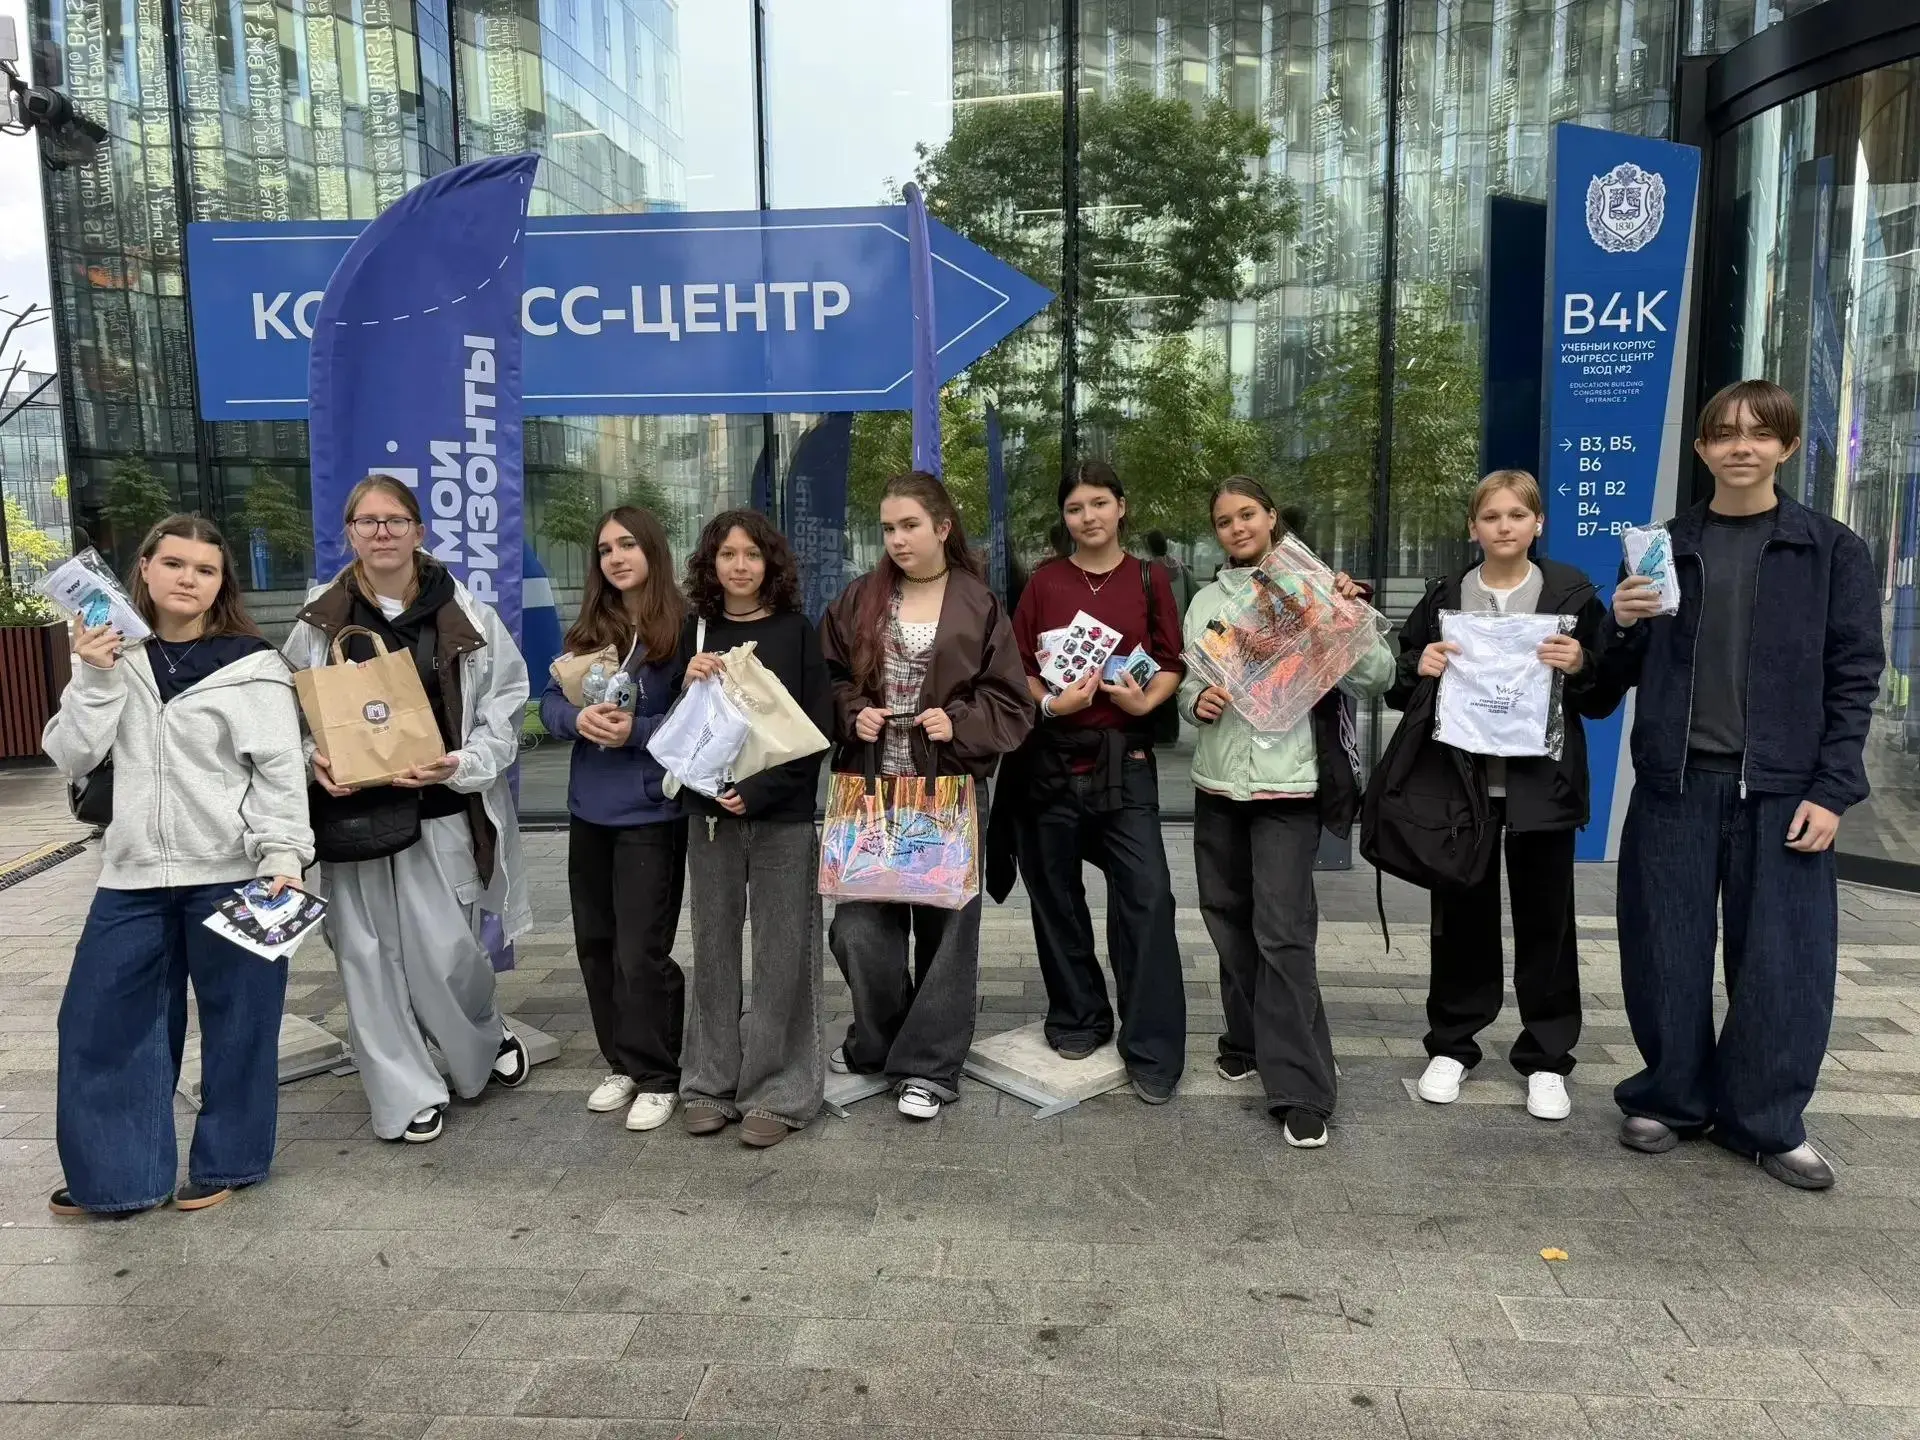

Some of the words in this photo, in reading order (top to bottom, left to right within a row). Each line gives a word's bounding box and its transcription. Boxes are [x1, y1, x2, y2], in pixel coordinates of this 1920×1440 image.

[1615, 222, 1634, 231] 1830
[252, 281, 851, 342] КОСС-ЦЕНТР
[1563, 290, 1668, 335] B4K
[1613, 340, 1656, 351] КОРПУС
[1561, 353, 1618, 364] КОНГРЕСС
[1620, 352, 1655, 363] ЦЕНТР
[1583, 366, 1613, 376] ВХОД
[1611, 380, 1644, 388] BUILDING
[463, 334, 499, 604] РИЗОНТЫ
[1579, 457, 1602, 472] B6
[1578, 481, 1596, 496] B1
[1604, 480, 1626, 496] B2
[1578, 501, 1601, 517] B4
